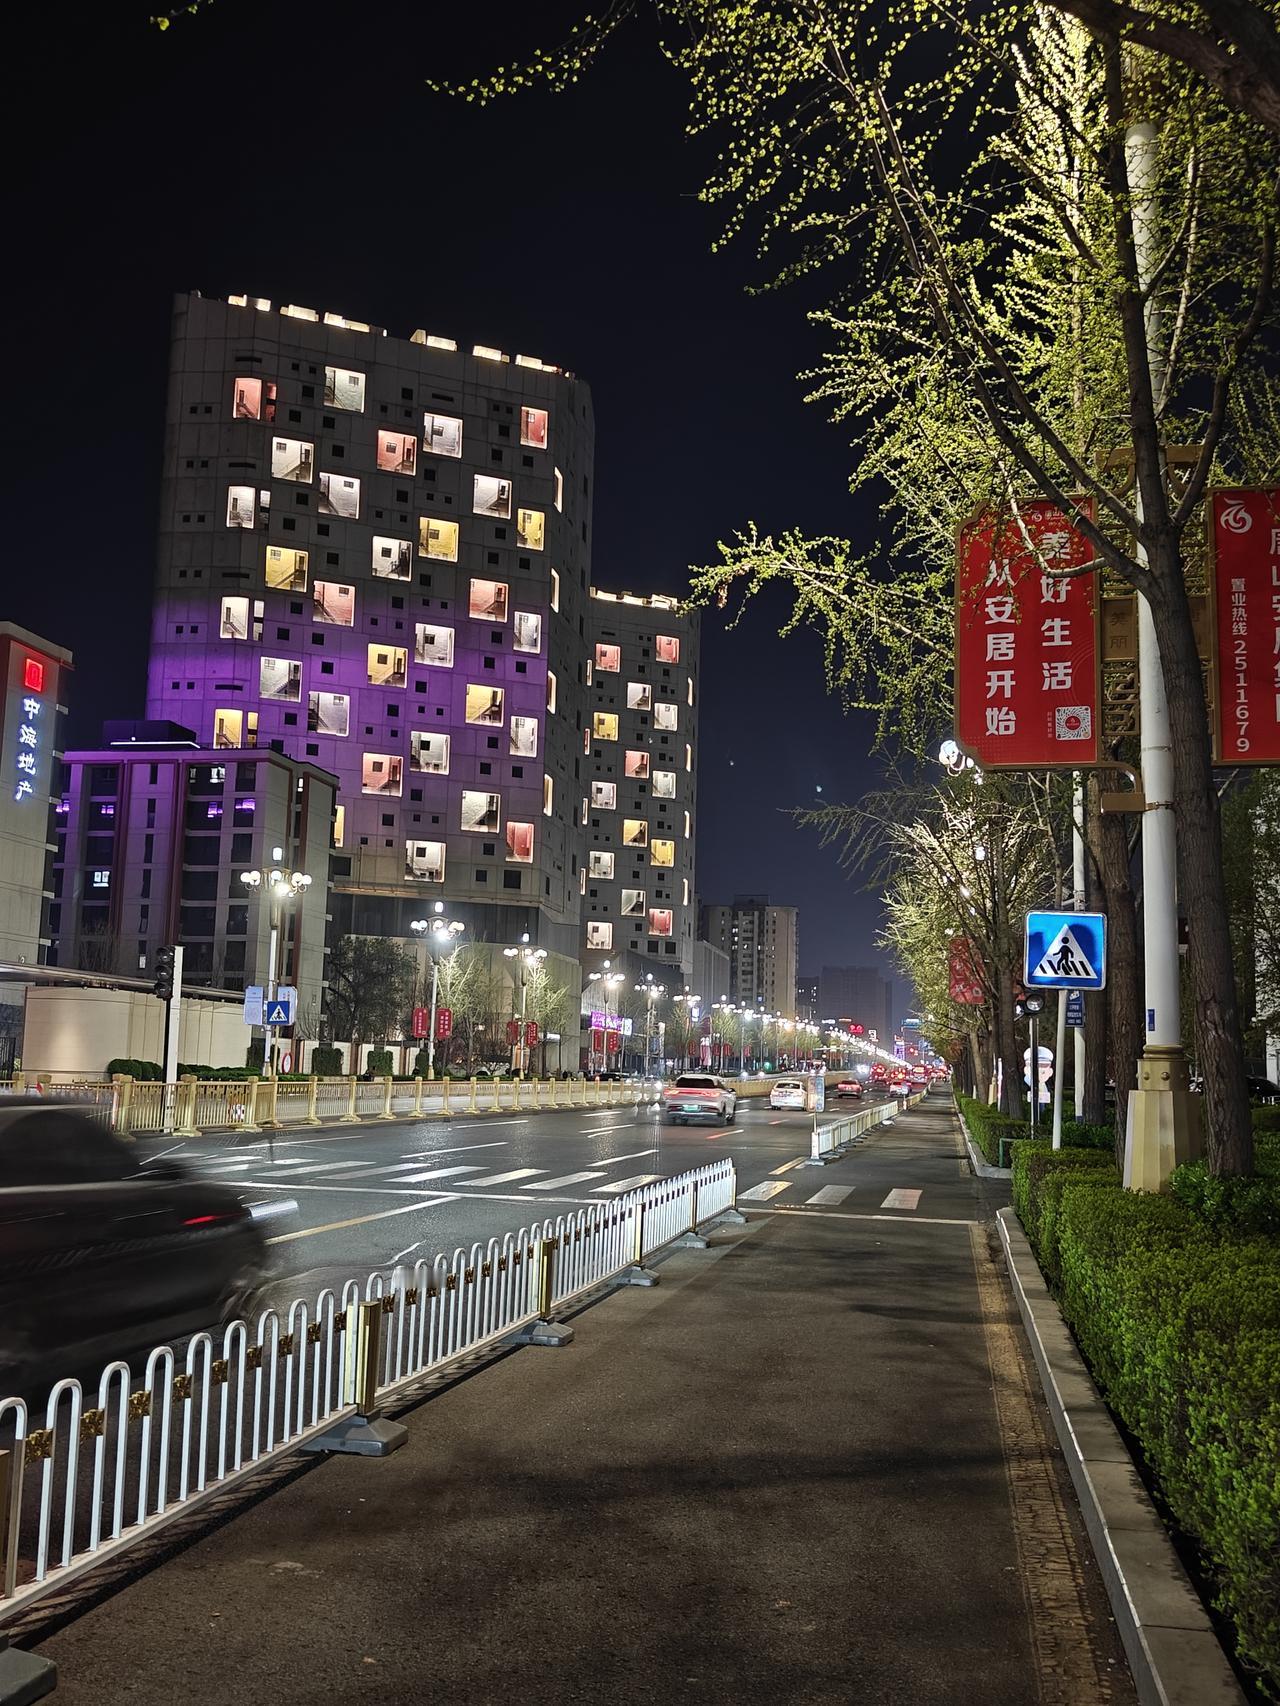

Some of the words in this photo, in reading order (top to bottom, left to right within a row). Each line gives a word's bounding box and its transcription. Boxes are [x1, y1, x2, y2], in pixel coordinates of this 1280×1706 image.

[984, 558, 1017, 737] 从安居开始
[1040, 531, 1072, 691] 美好生活
[1231, 578, 1248, 636] 置业热线
[16, 698, 41, 800] 中海地产
[1233, 640, 1250, 752] 2511679
